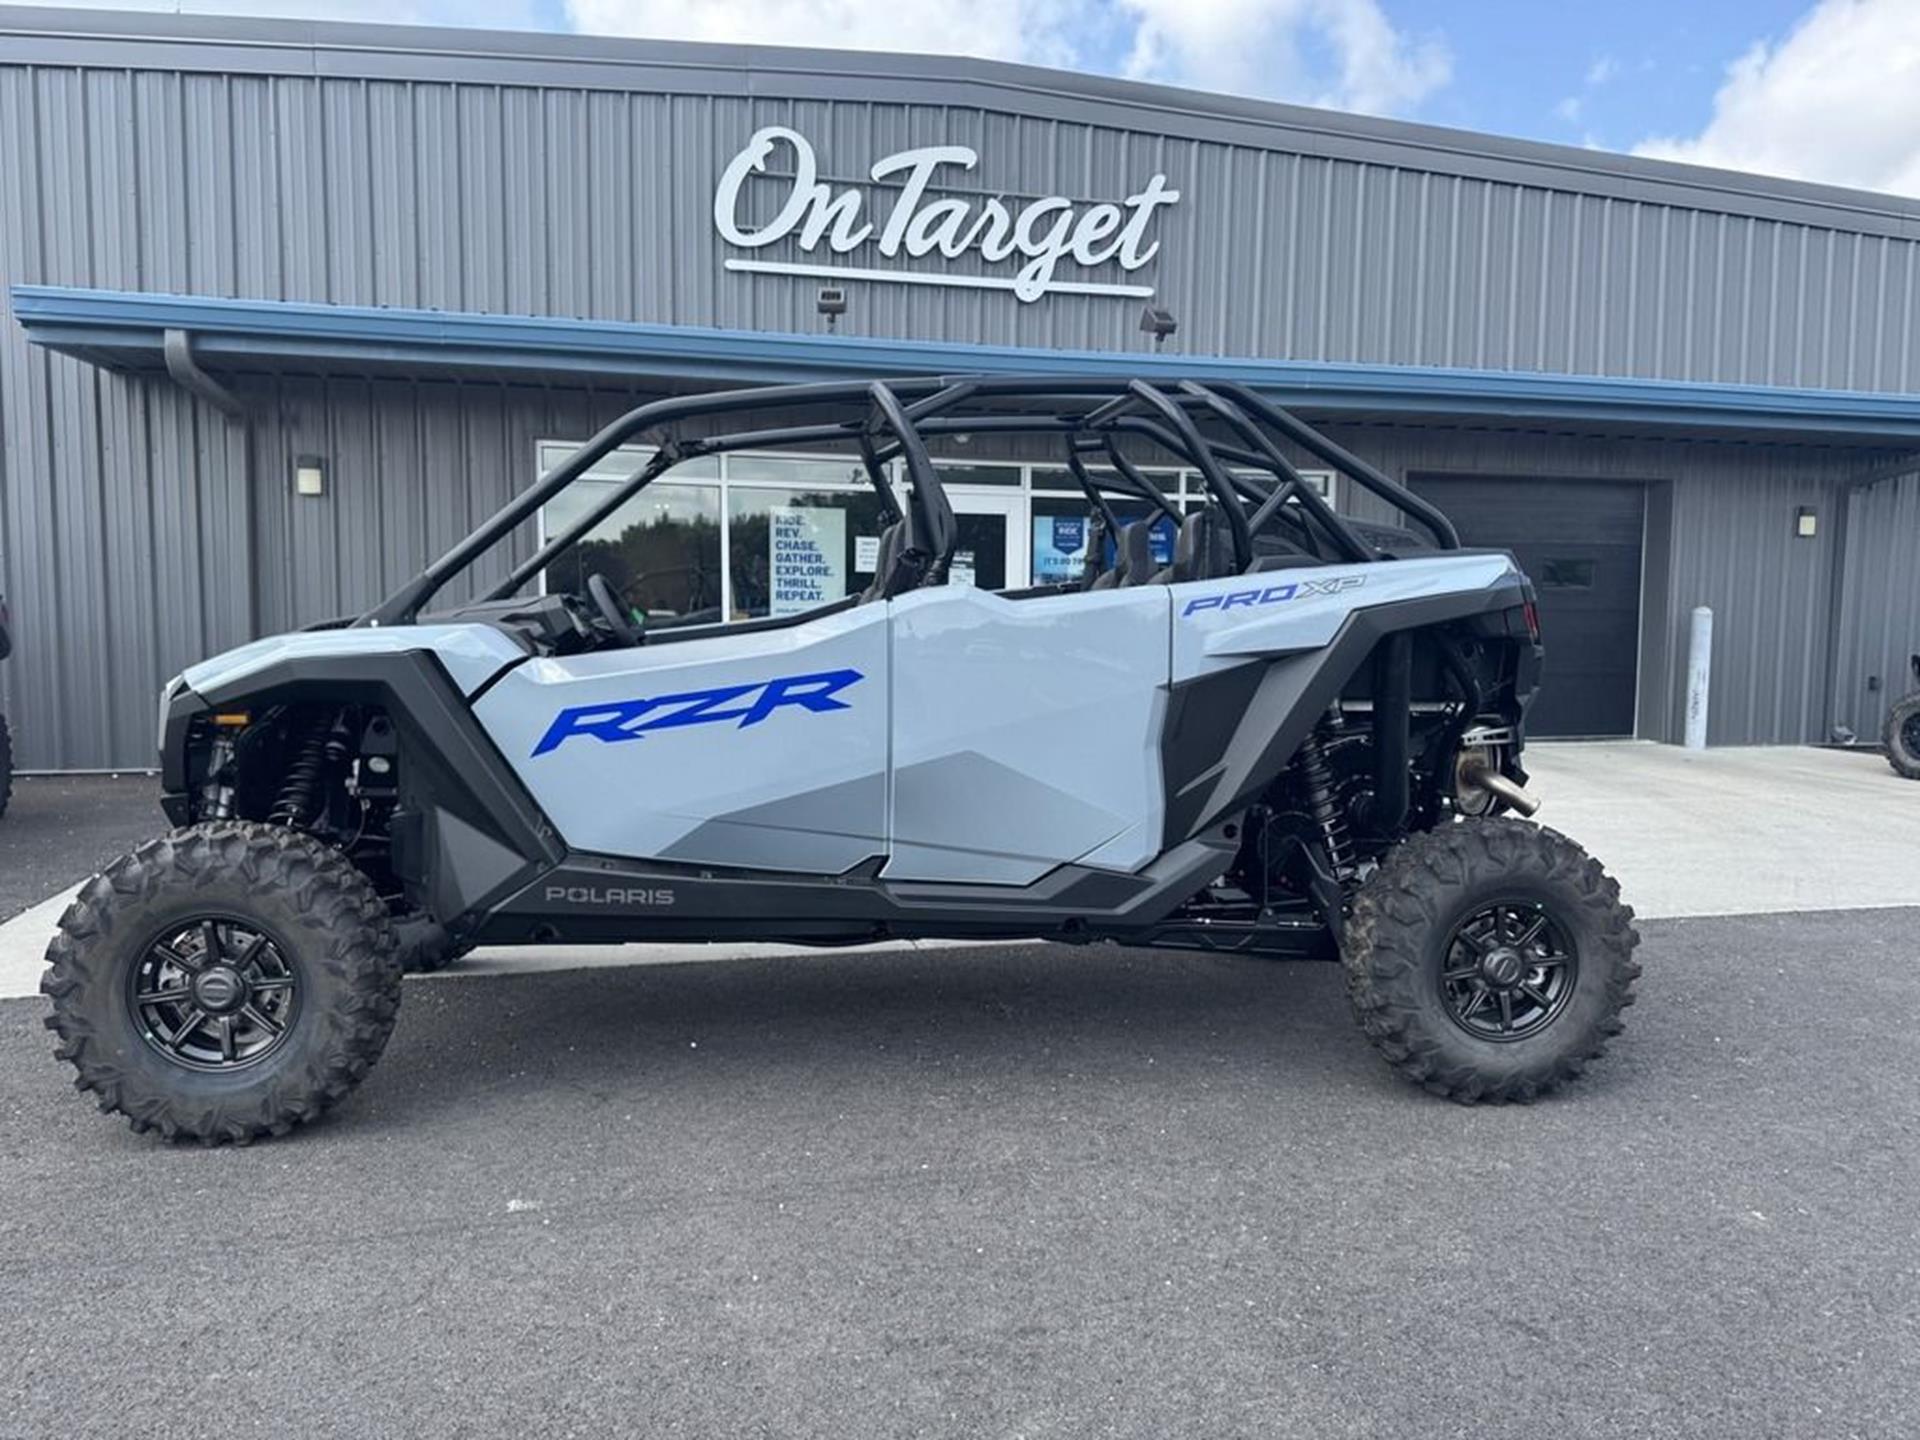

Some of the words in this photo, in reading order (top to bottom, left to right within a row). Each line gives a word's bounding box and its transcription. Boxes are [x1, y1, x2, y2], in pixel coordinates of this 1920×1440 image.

[775, 528, 803, 539] REV.
[775, 540, 820, 551] CHASE.
[775, 553, 826, 564] GATHER.
[775, 566, 835, 576] EXPLORE.
[776, 578, 822, 589] THRILL.
[775, 590, 825, 601] REPEAT.
[530, 669, 864, 758] RZR
[545, 886, 675, 905] POLARIS
